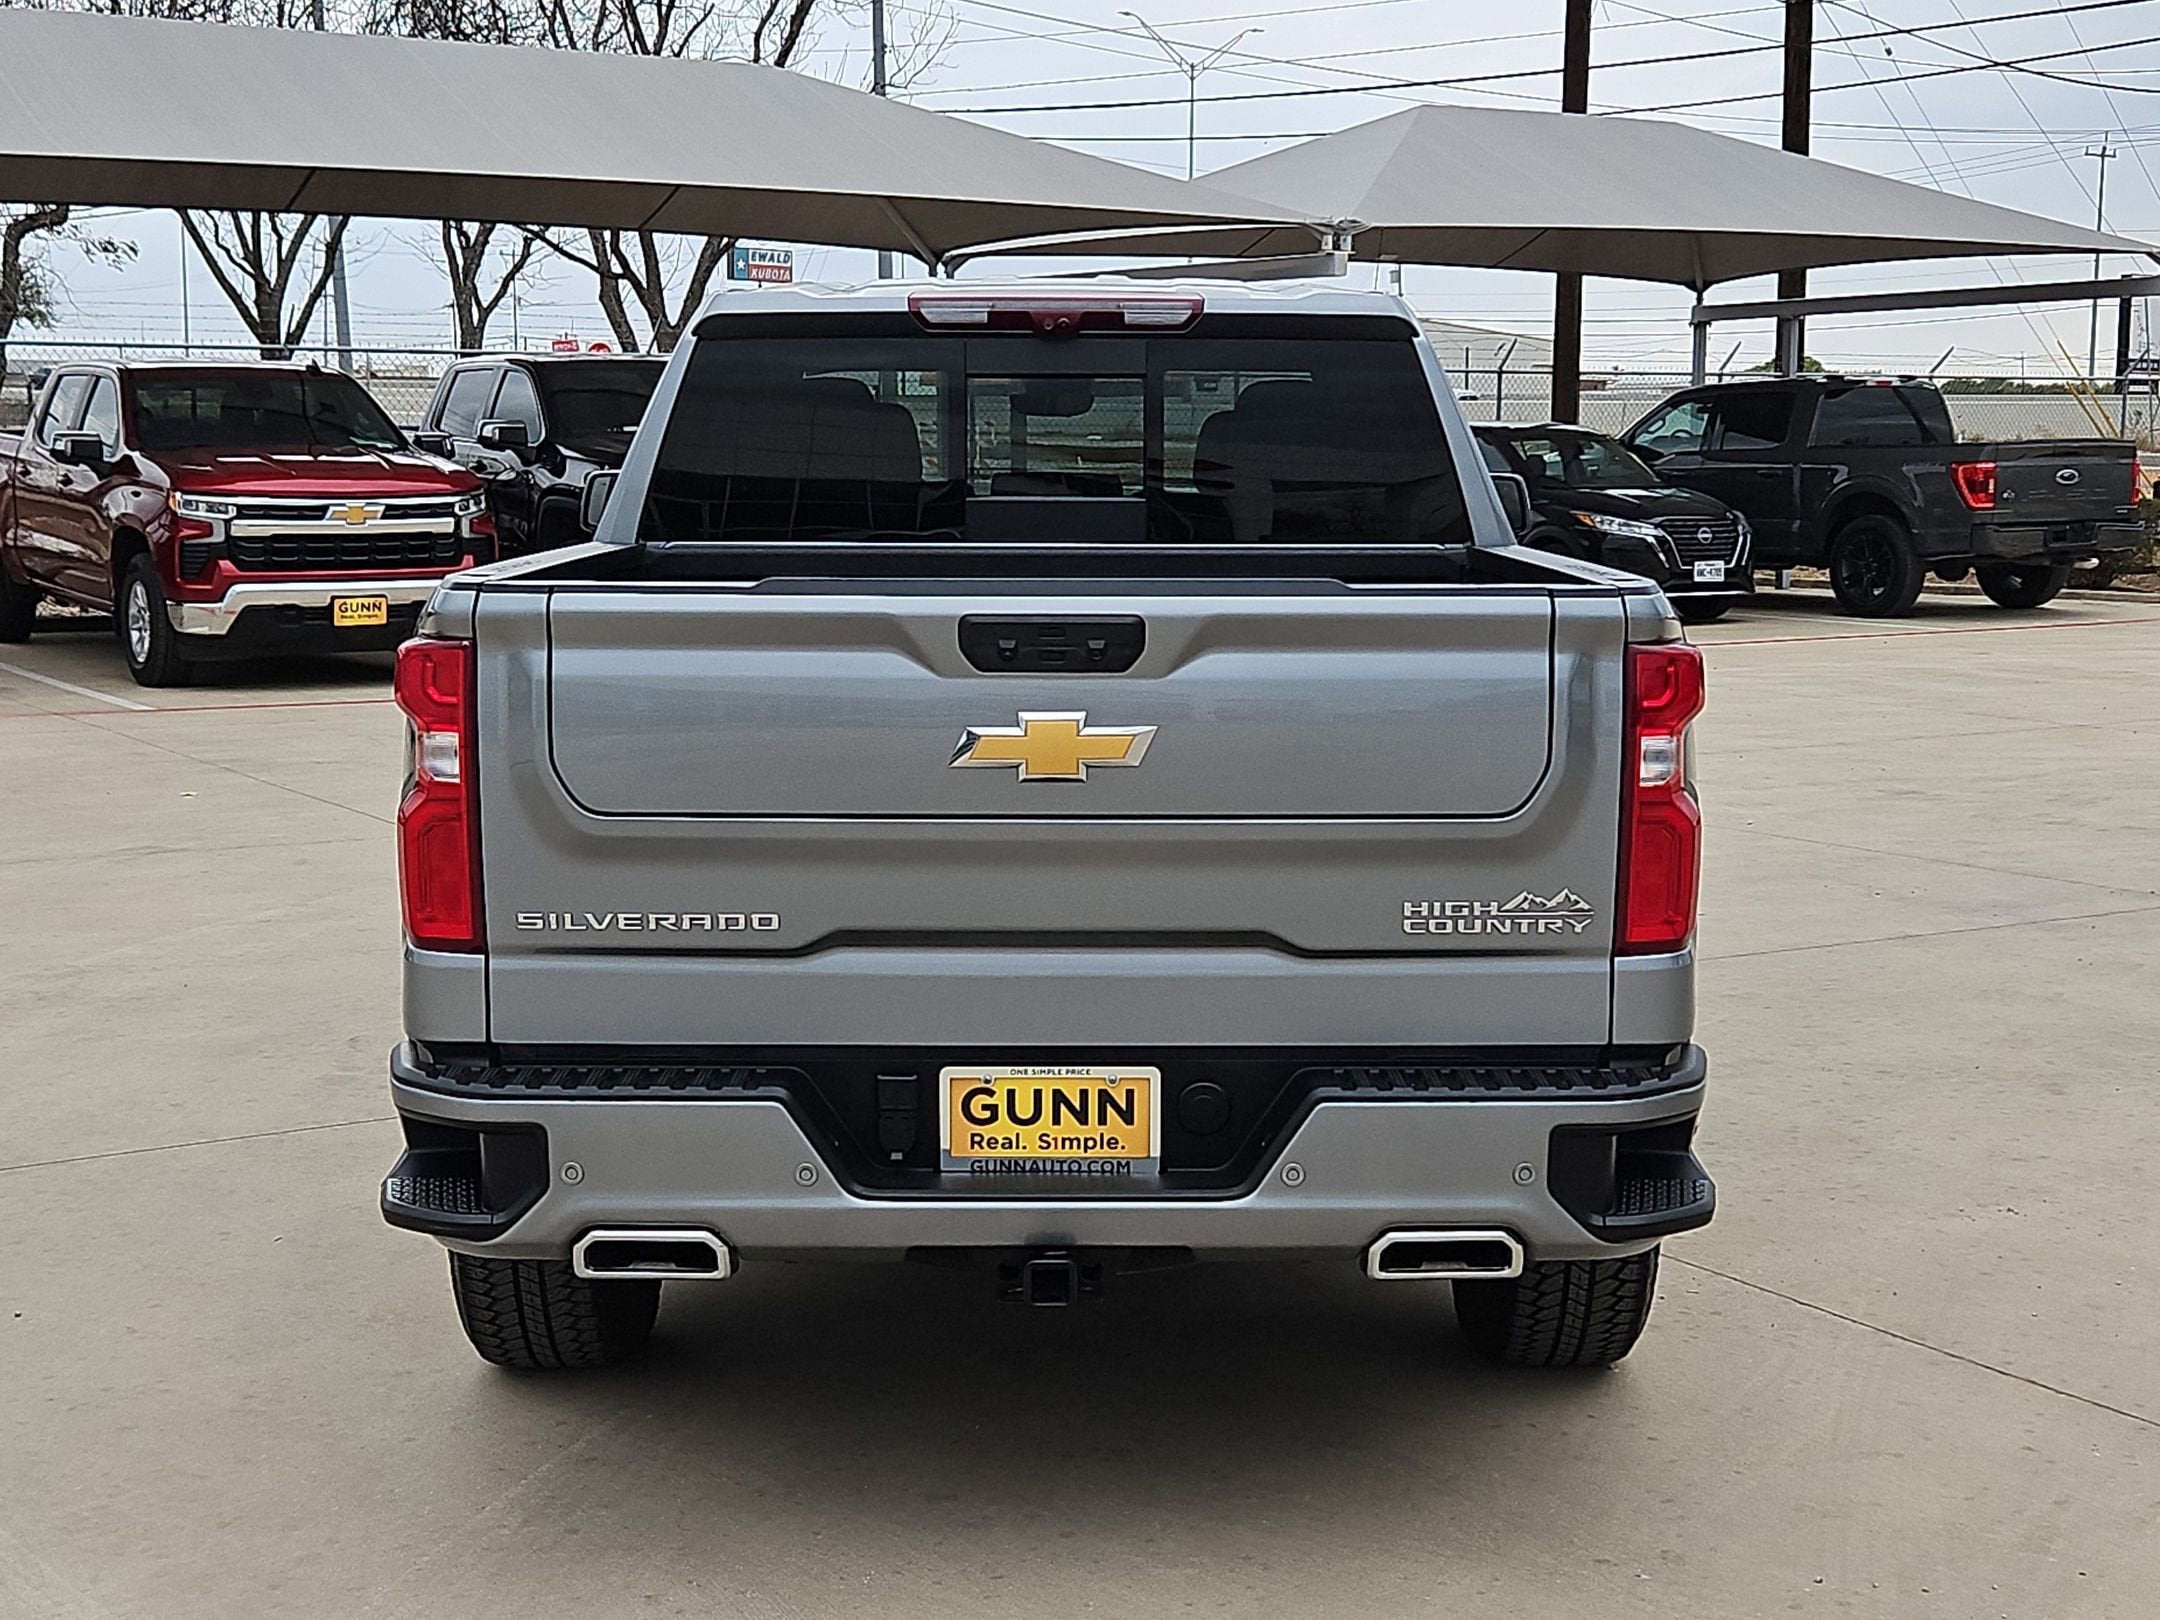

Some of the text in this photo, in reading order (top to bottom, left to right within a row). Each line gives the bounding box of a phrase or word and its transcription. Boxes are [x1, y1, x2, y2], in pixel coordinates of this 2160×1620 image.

[750, 251, 791, 264] EWALD
[751, 267, 791, 281] KUBOTA
[338, 600, 382, 613] GUNN
[1403, 901, 1499, 917] HIGH
[516, 912, 781, 931] SILVERADO
[1402, 918, 1593, 934] COUNTRY
[1009, 1068, 1092, 1076] ONE SIMPLE PRICE
[960, 1086, 1136, 1127] GUNN
[969, 1132, 1028, 1151] Real.
[970, 1158, 1132, 1175] GUNNAUTO.COM
